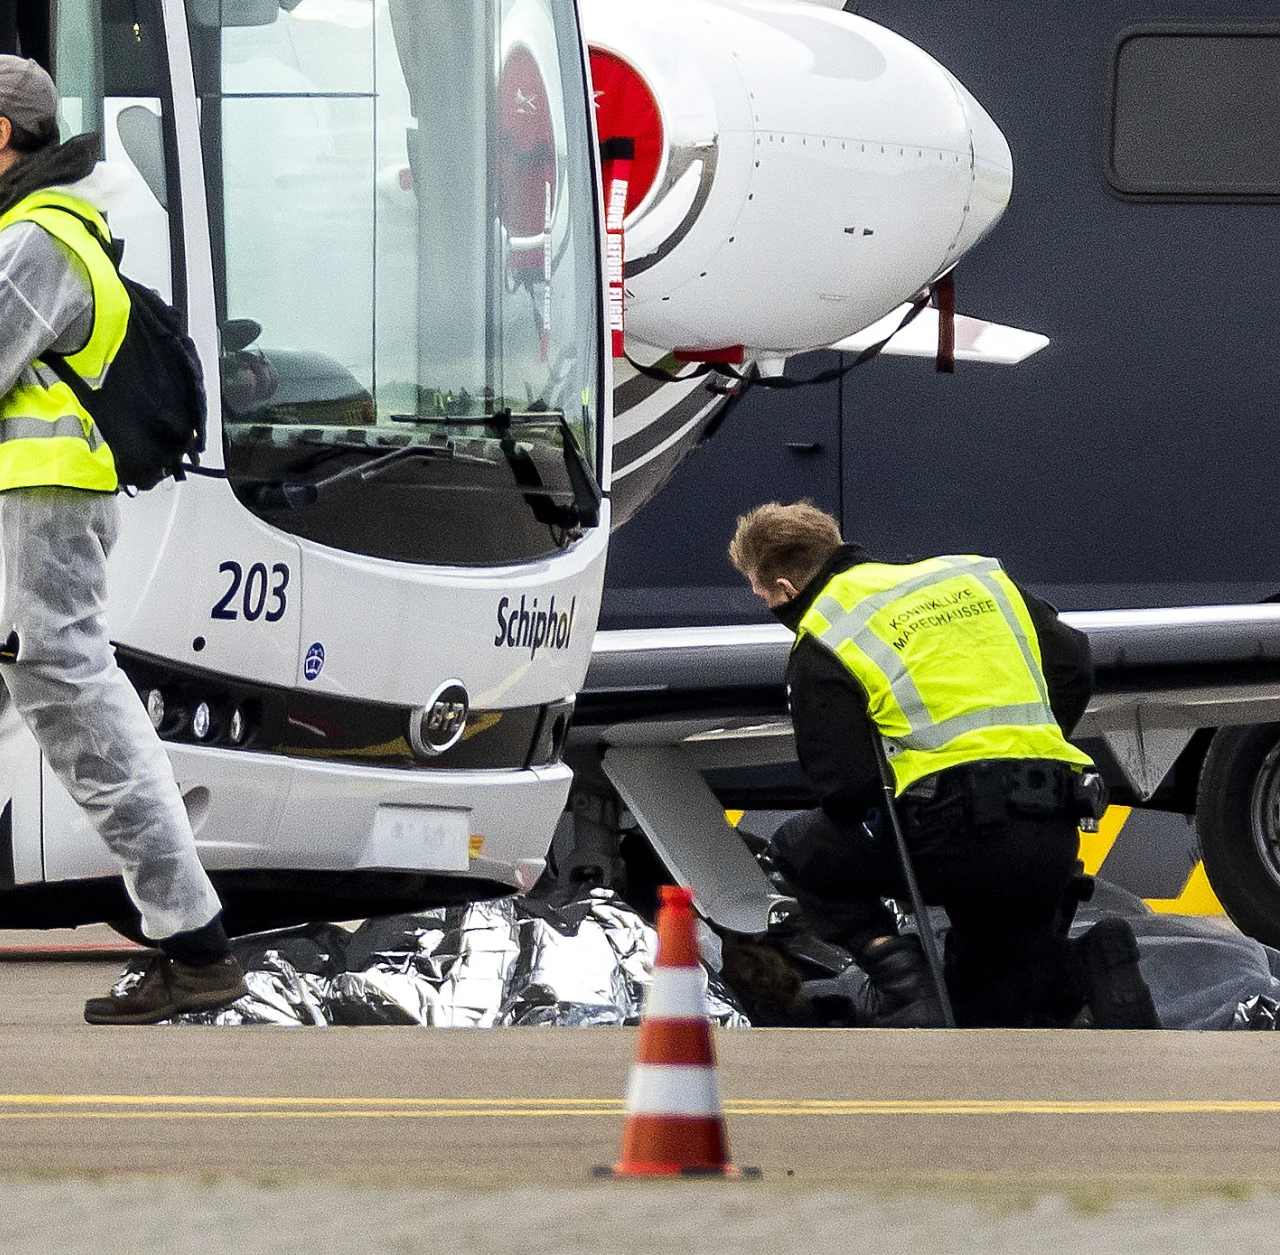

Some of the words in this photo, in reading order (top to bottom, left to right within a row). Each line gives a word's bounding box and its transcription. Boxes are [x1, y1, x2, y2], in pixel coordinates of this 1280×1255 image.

[210, 560, 290, 622] 203
[889, 588, 977, 631] KONINKLIJKE
[494, 594, 576, 661] Schiphol
[892, 599, 997, 651] MARECHAUSSEE
